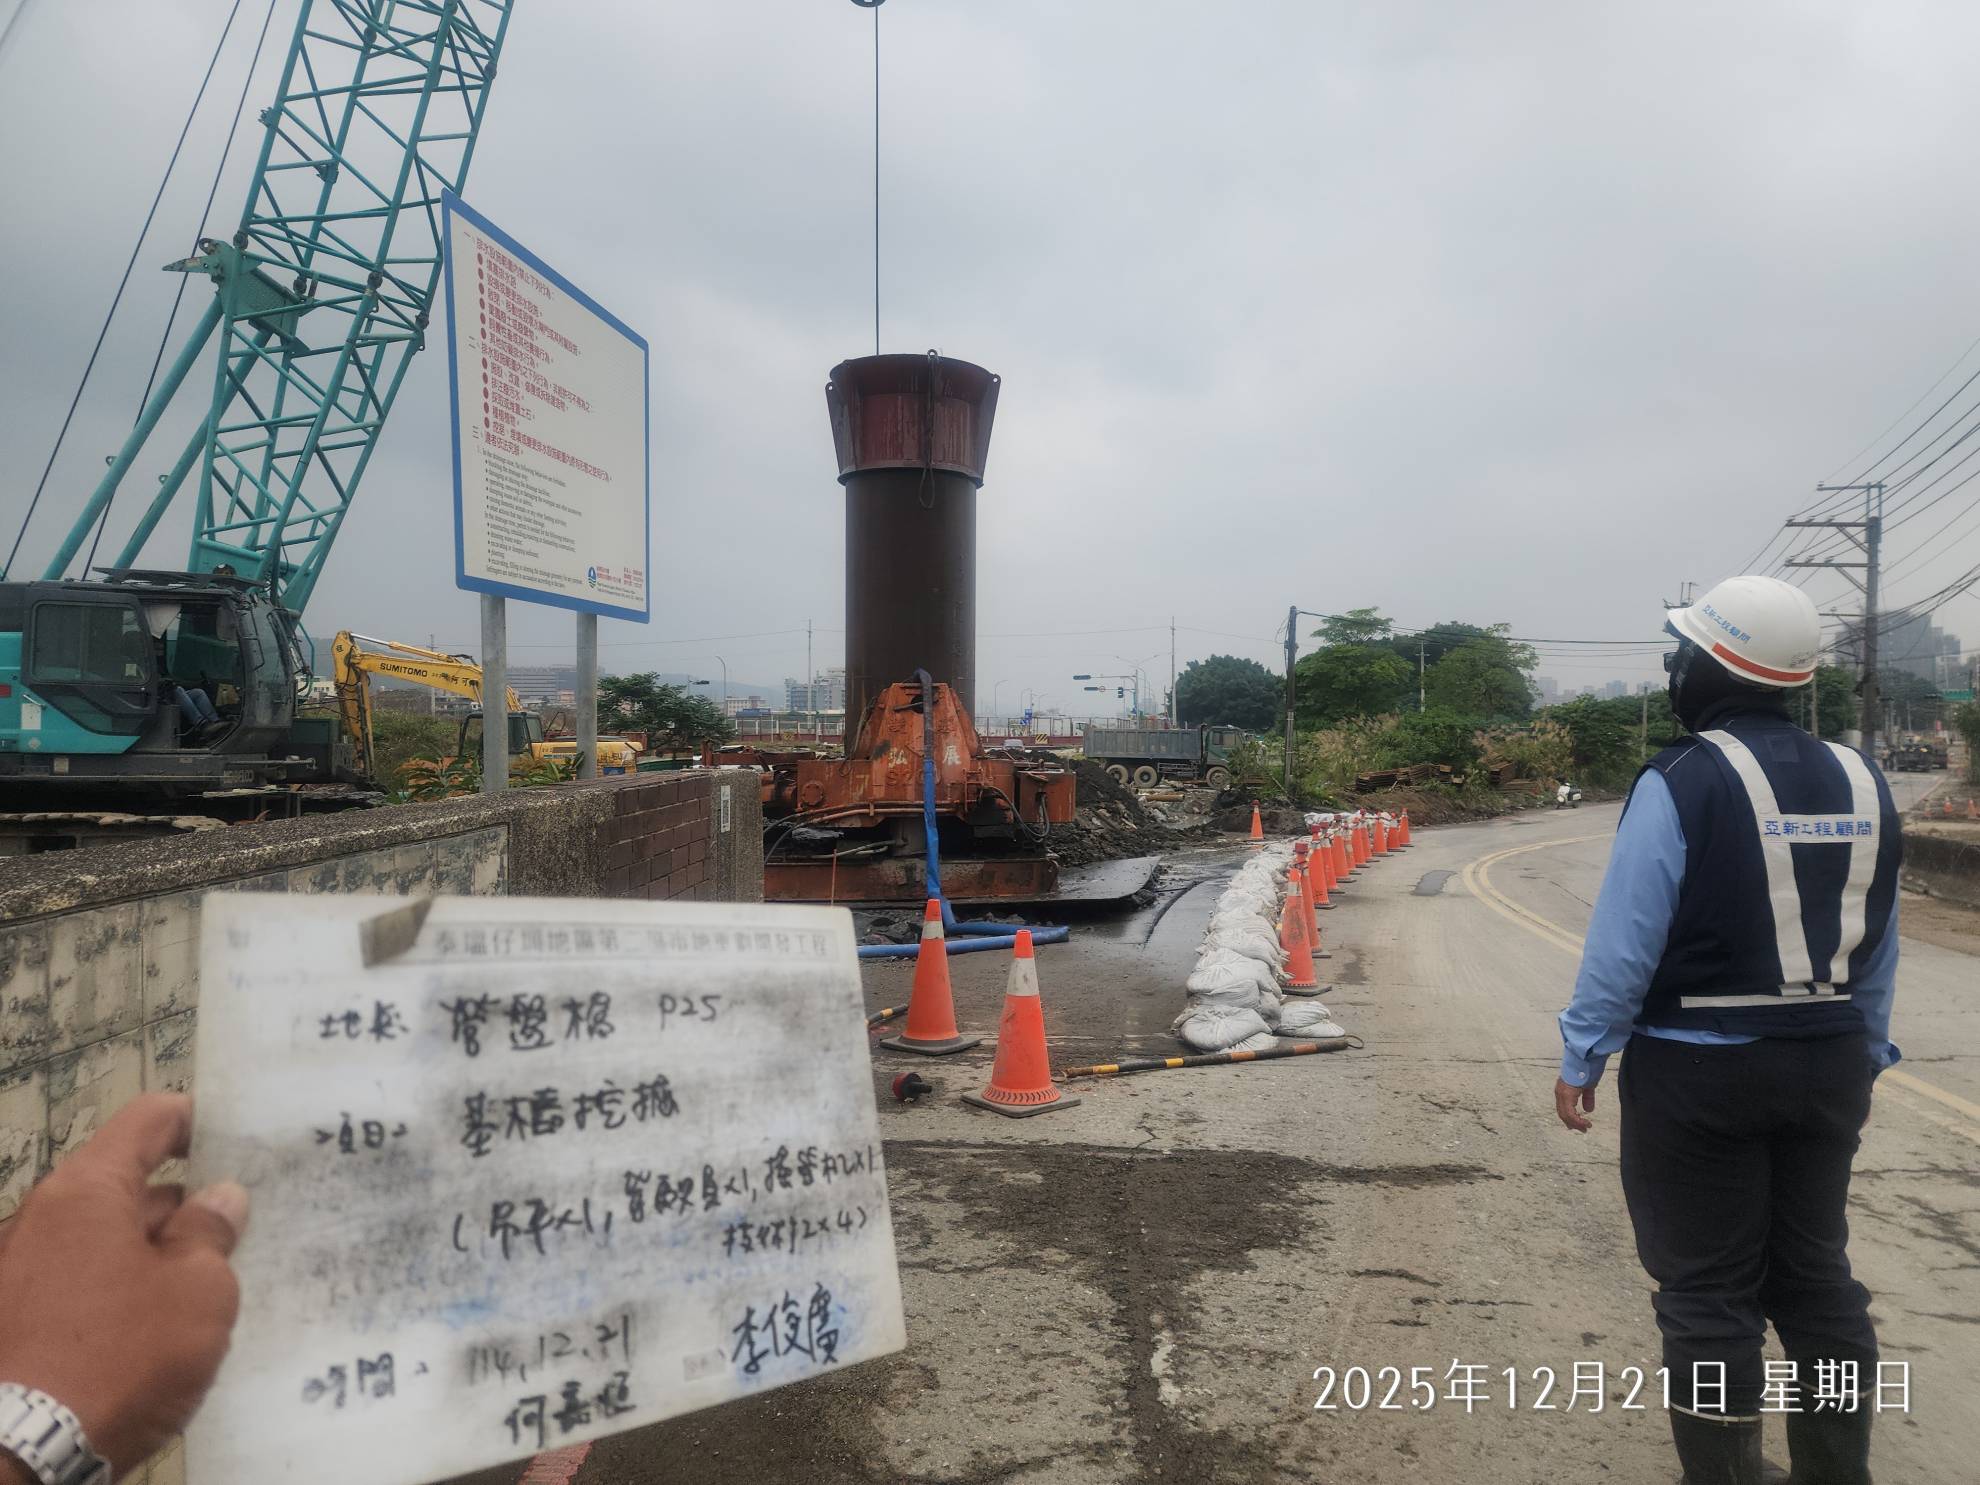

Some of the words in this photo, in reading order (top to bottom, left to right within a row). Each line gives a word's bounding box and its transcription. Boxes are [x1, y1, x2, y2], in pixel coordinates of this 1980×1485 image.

[380, 663, 428, 678] SUMITOMO
[1764, 820, 1873, 837] 亞新工程顧問
[658, 994, 722, 1030] P25
